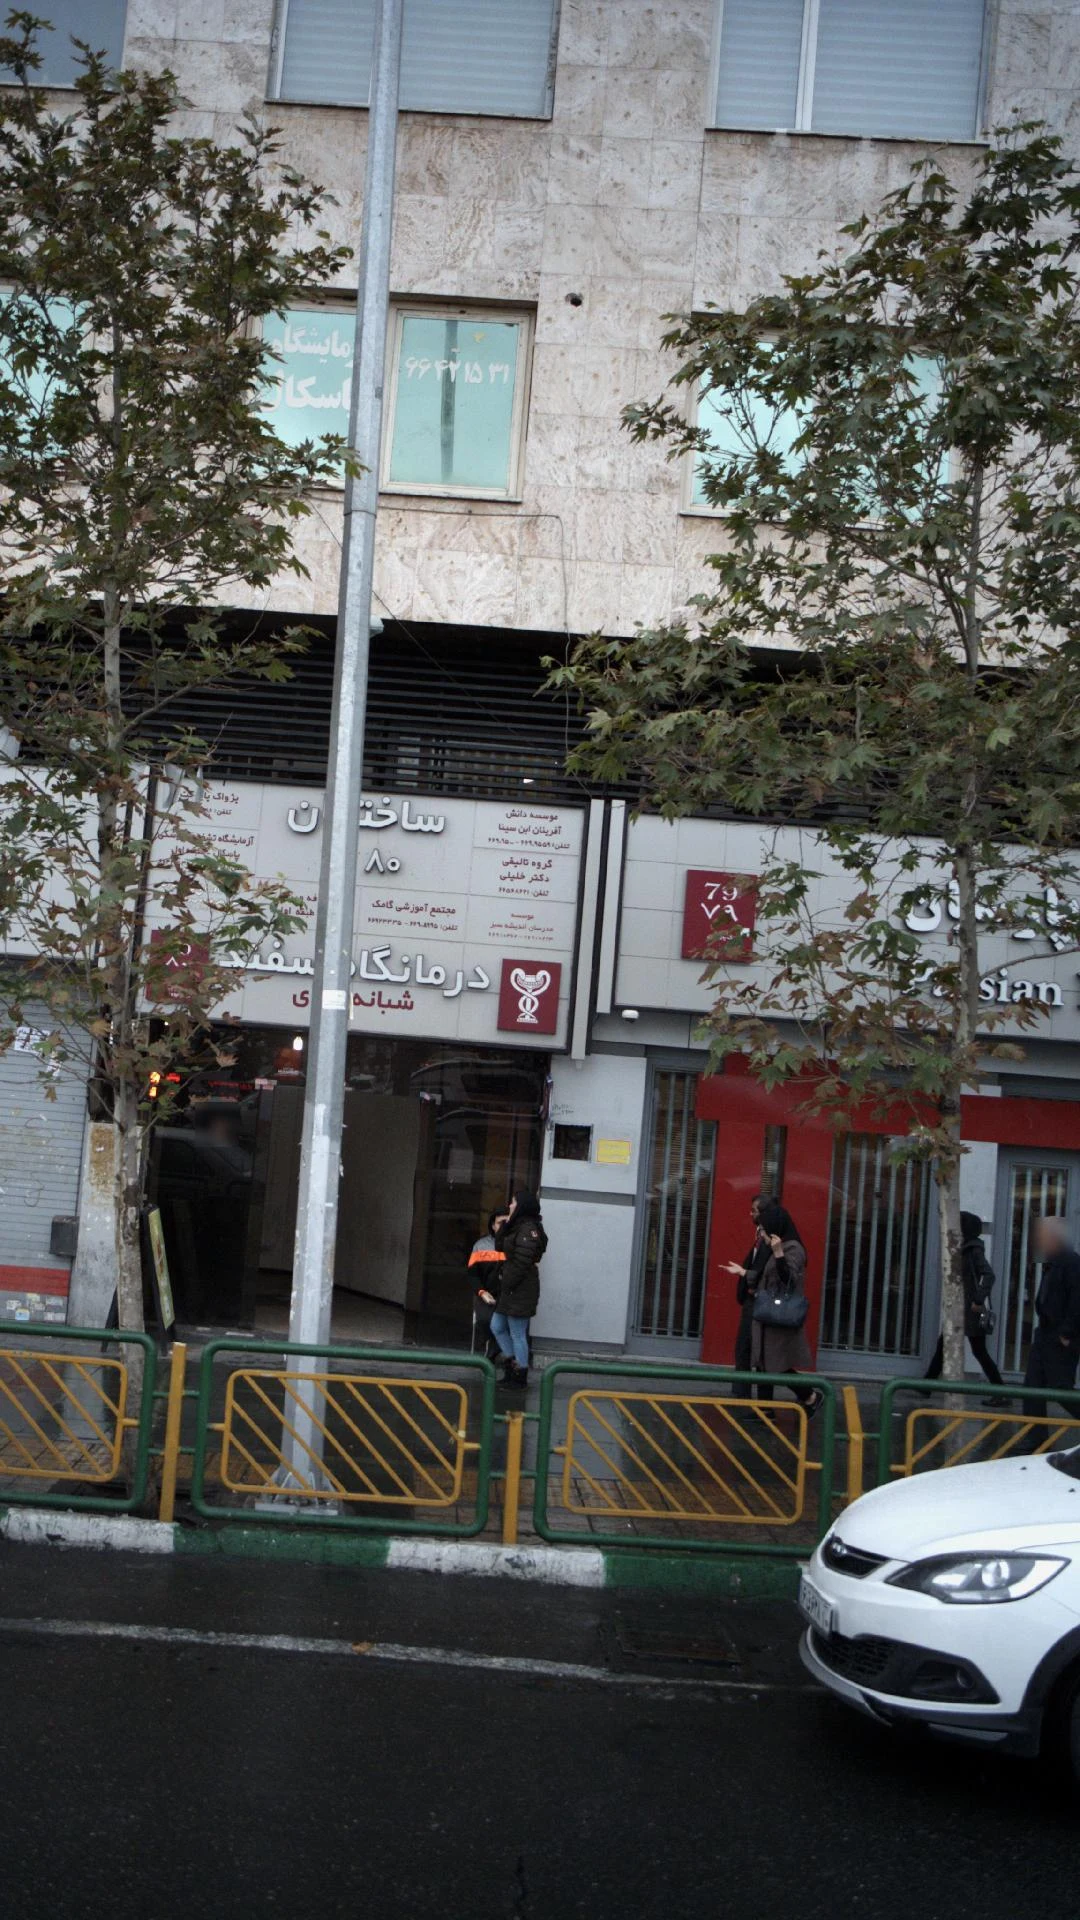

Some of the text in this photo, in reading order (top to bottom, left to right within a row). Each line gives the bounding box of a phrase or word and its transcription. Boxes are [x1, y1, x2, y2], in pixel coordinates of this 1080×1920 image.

[287, 796, 445, 834] ساختن
[505, 809, 559, 822] موسسه دانش
[498, 824, 517, 834] سینا
[518, 825, 531, 834] ابن
[365, 848, 400, 874] ۸۰
[532, 859, 552, 870] گروه
[499, 872, 550, 884] دکتر خلیلی
[395, 902, 429, 914] آموزشی
[430, 906, 456, 917] مجتمع
[700, 902, 739, 922] ۷۹
